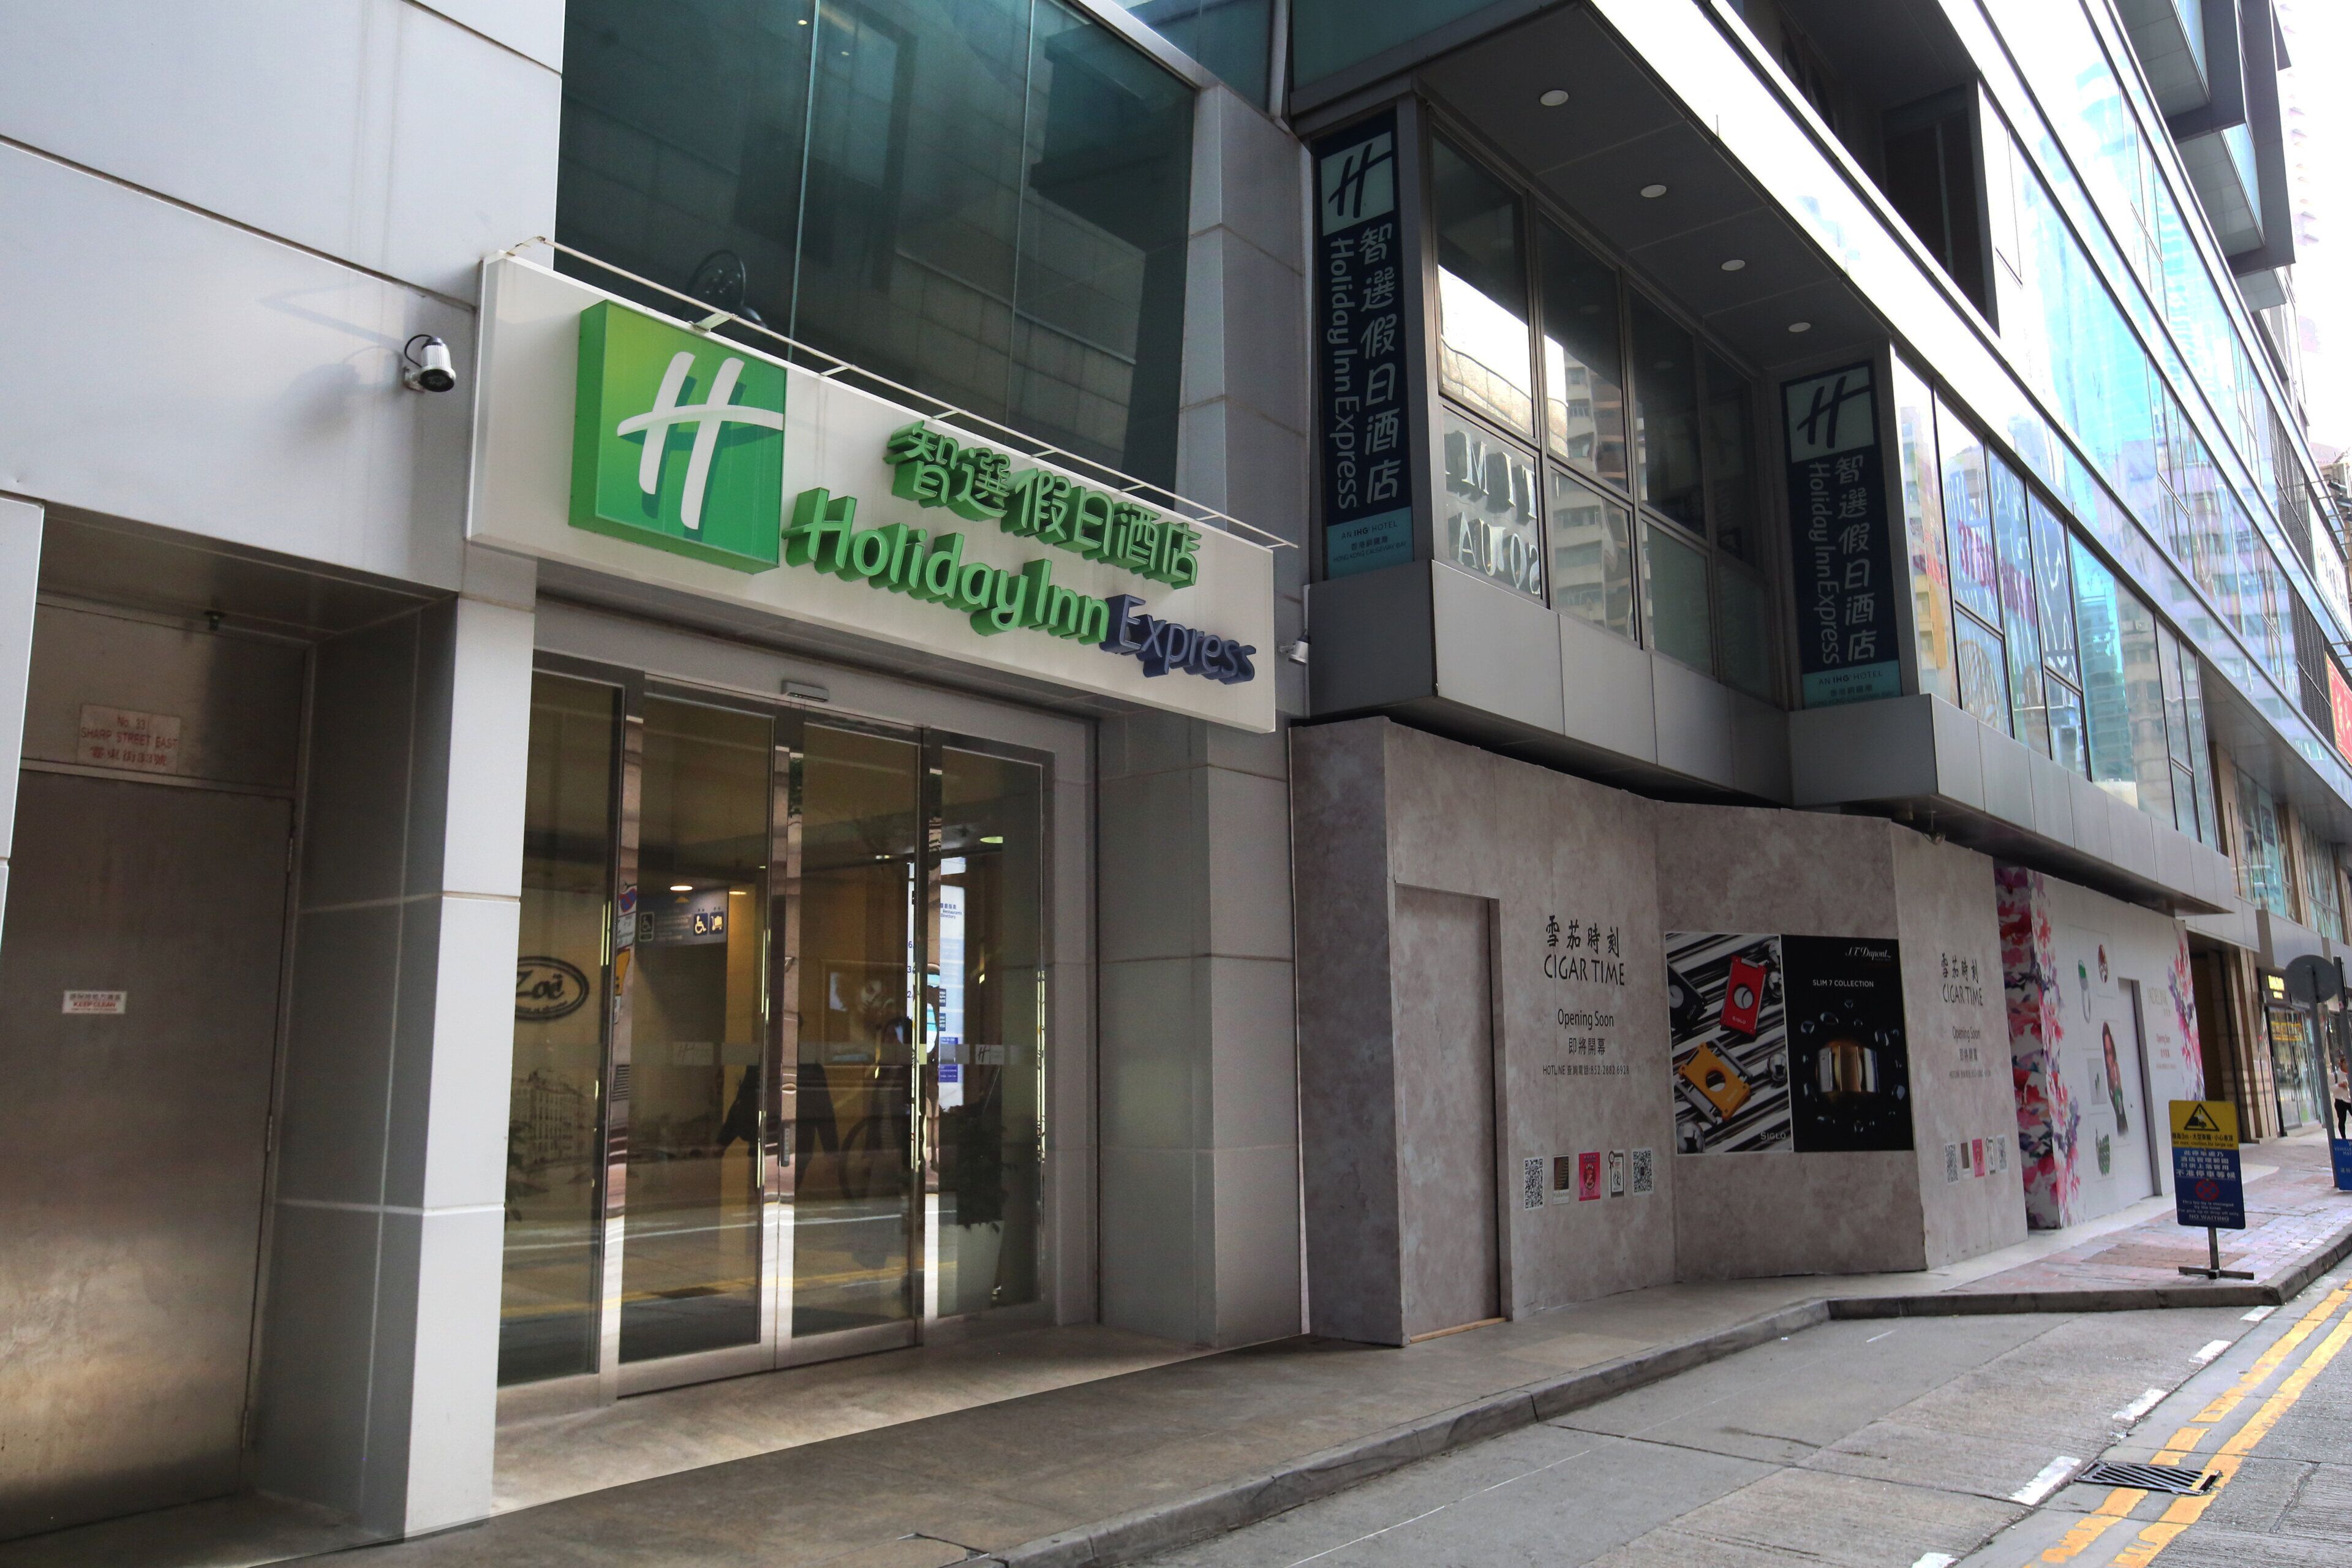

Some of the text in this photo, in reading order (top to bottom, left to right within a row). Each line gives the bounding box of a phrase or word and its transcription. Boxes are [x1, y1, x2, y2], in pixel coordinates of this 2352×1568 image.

[1327, 238, 1360, 510] Holiday Inn Express
[1359, 223, 1401, 503] 智選假日酒店
[883, 420, 1202, 589] 智選假日酒店
[1354, 527, 1369, 537] IHG
[1372, 520, 1397, 532] HOTEL
[1333, 554, 1349, 563] HONG
[1350, 551, 1365, 559] KONG
[1396, 541, 1407, 549] BAY
[1808, 461, 1839, 665] Holiday Inn Express
[1835, 454, 1877, 662] 智選假日酒店
[783, 488, 1256, 685] Holiday Inn Express
[1833, 675, 1850, 684] IHG
[1853, 670, 1883, 680] HOTEL
[116, 732, 151, 745] STREET
[156, 737, 178, 748] EAST
[1546, 915, 1619, 959] 雪茄時刻
[1544, 954, 1625, 986] CIGAR TIME
[1943, 983, 1983, 1006] CIGAR TIME
[1558, 1009, 1615, 1030] Opening Soon
[1569, 1037, 1605, 1056] 即將開幕
[1953, 1026, 1980, 1043] Opening Soon
